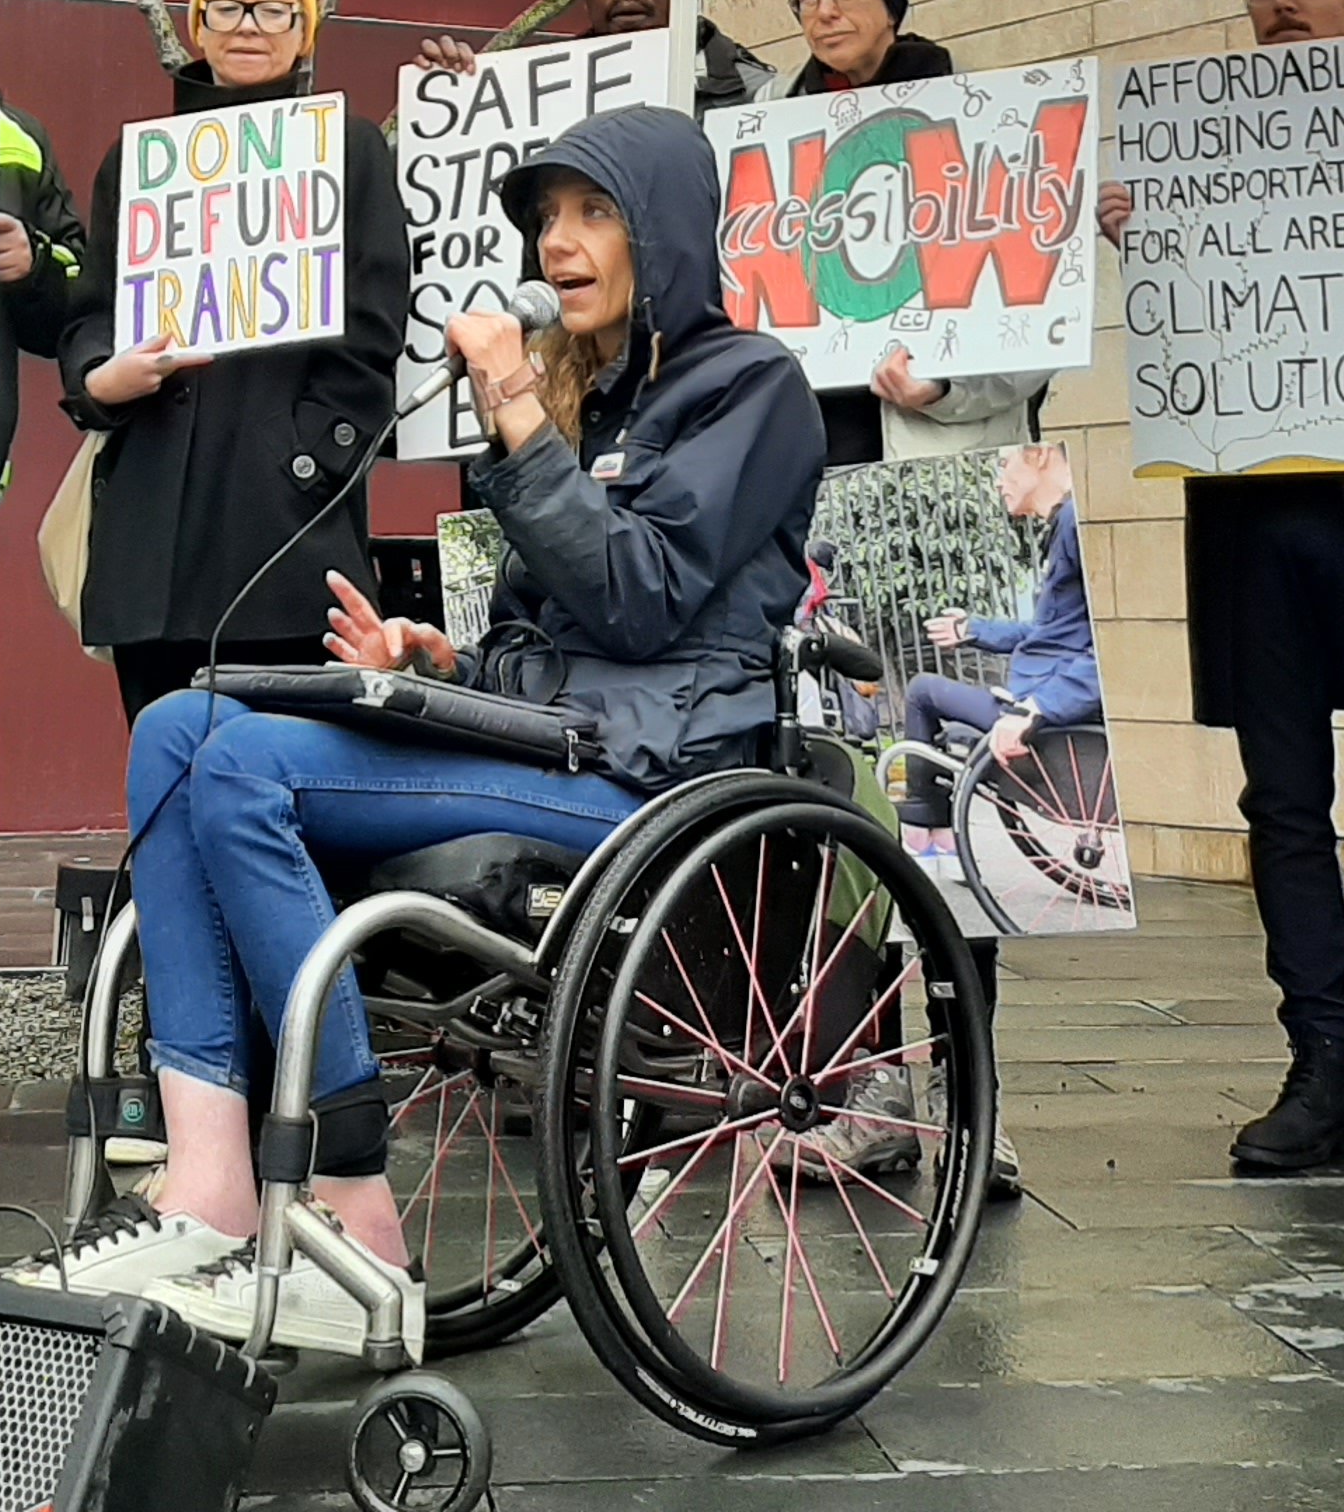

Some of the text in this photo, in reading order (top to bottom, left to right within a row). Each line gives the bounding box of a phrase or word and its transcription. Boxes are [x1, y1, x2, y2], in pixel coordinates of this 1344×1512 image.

[410, 40, 646, 139] SAFE
[136, 99, 338, 190] DON'T
[1118, 110, 1292, 162] HOUSING
[128, 169, 341, 265] DEFUND
[412, 225, 503, 275] FOR
[1123, 230, 1185, 265] FOR
[1199, 222, 1272, 258] ALL
[122, 243, 340, 347] TRANSIT
